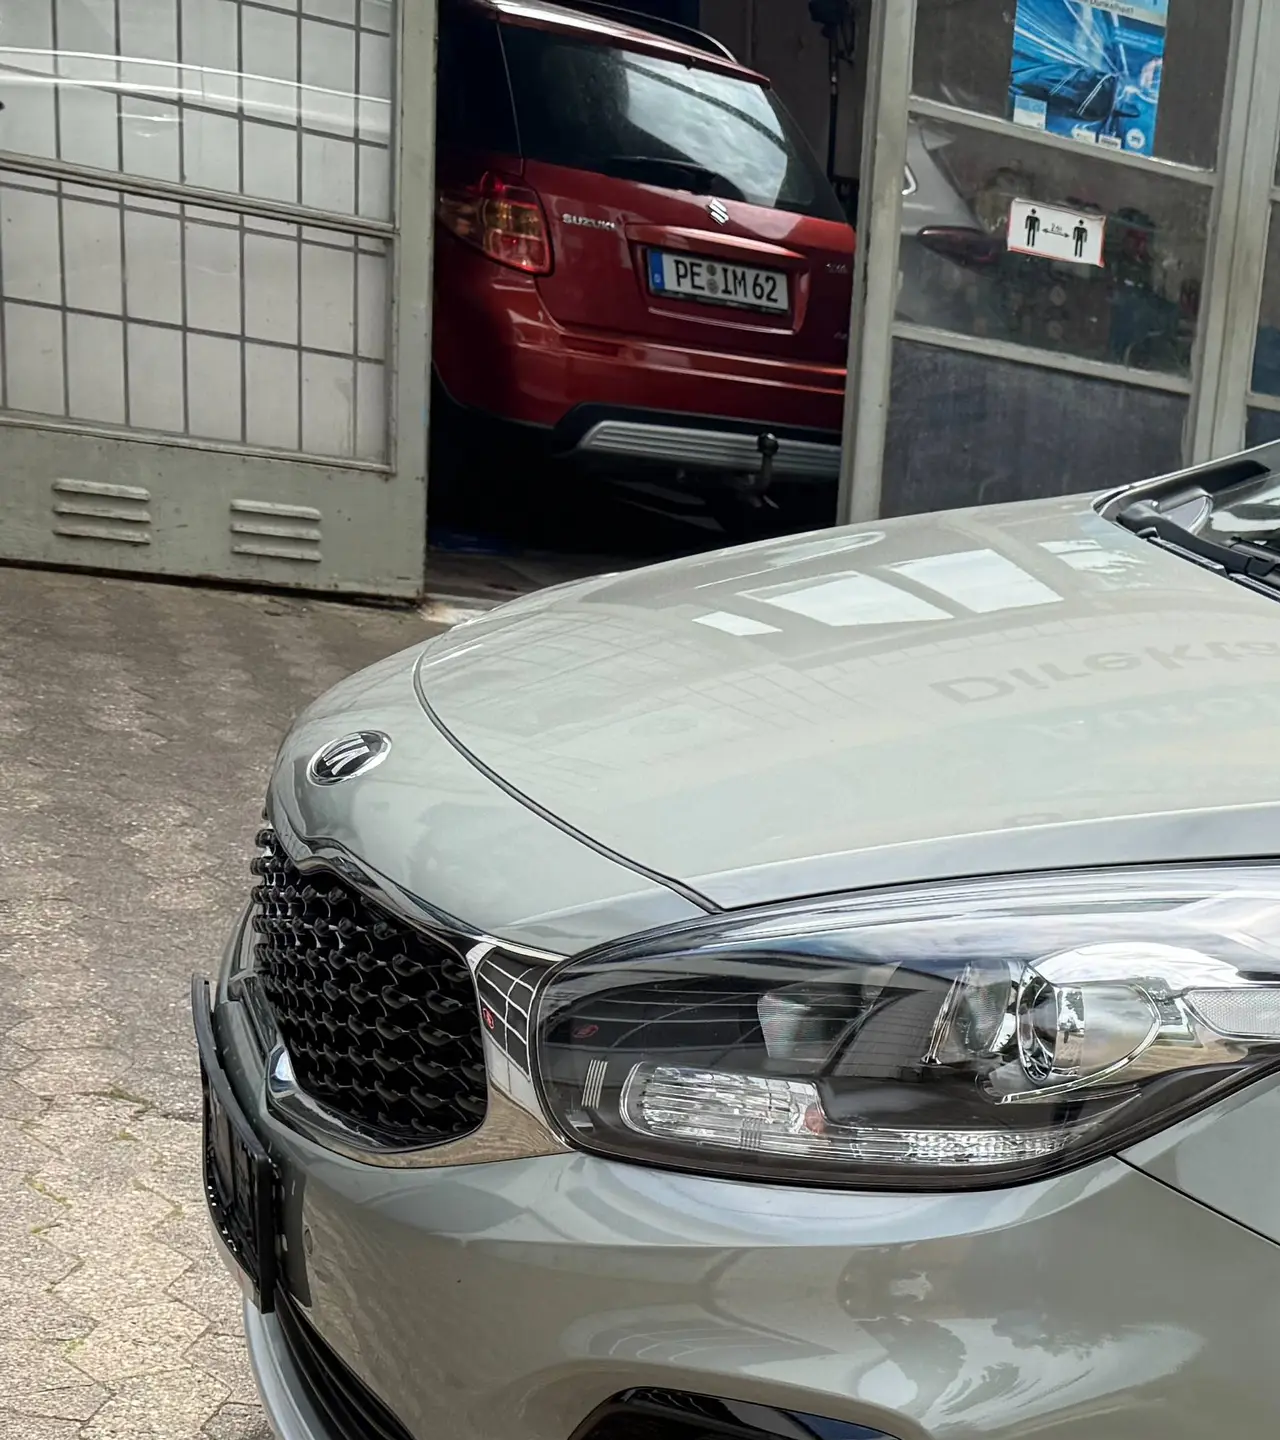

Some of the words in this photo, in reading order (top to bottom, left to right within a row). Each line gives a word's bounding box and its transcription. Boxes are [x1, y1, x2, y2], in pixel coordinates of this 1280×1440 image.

[562, 213, 615, 230] SUZUKI
[674, 258, 706, 292] PE
[721, 267, 748, 299] IM
[751, 274, 778, 303] 62
